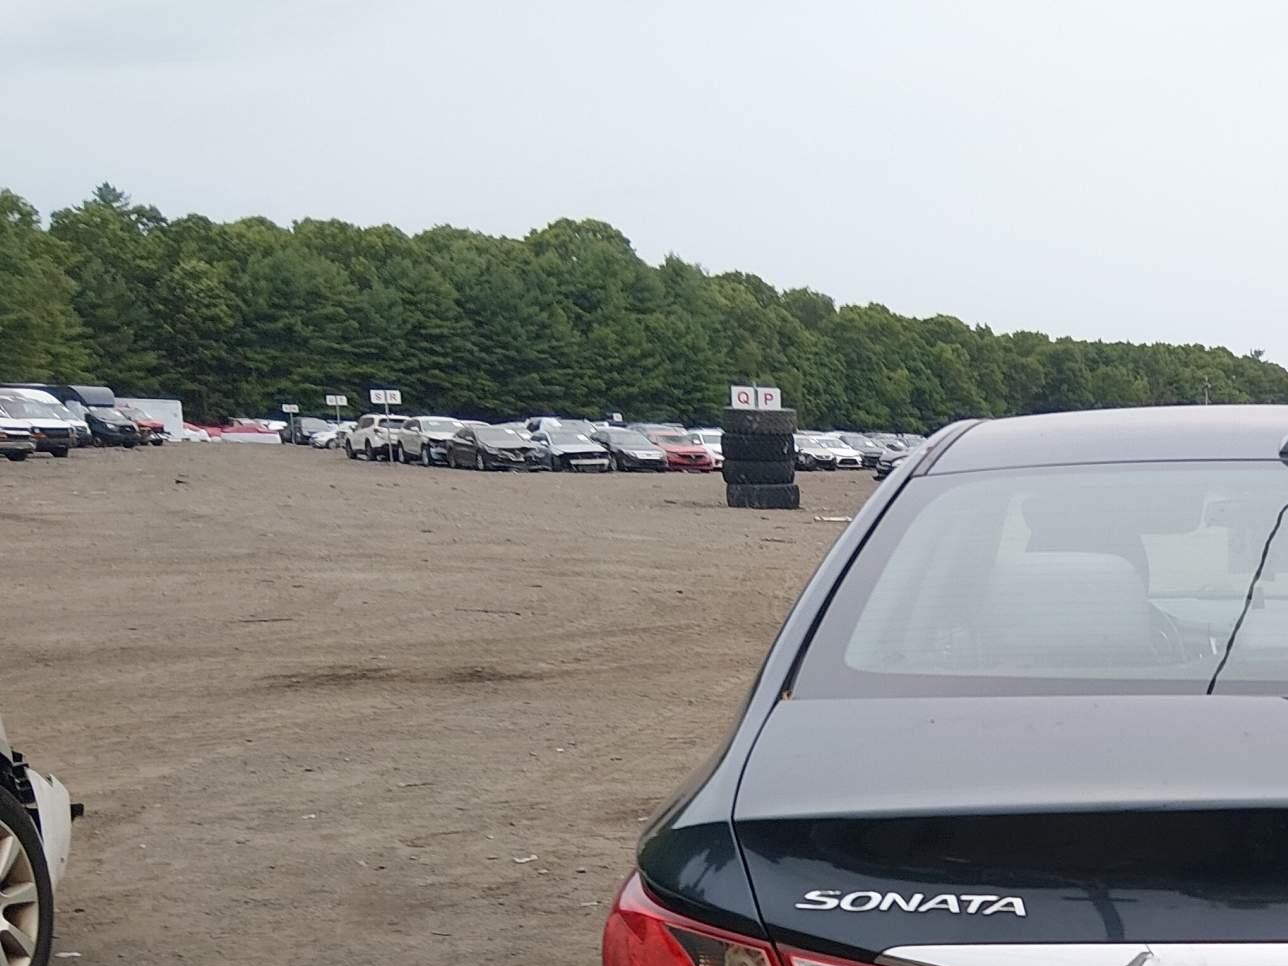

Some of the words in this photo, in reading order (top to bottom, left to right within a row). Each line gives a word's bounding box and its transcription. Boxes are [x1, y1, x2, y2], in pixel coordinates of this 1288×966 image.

[737, 391, 750, 405] Q
[764, 392, 774, 406] P
[795, 890, 1026, 917] SONATA
